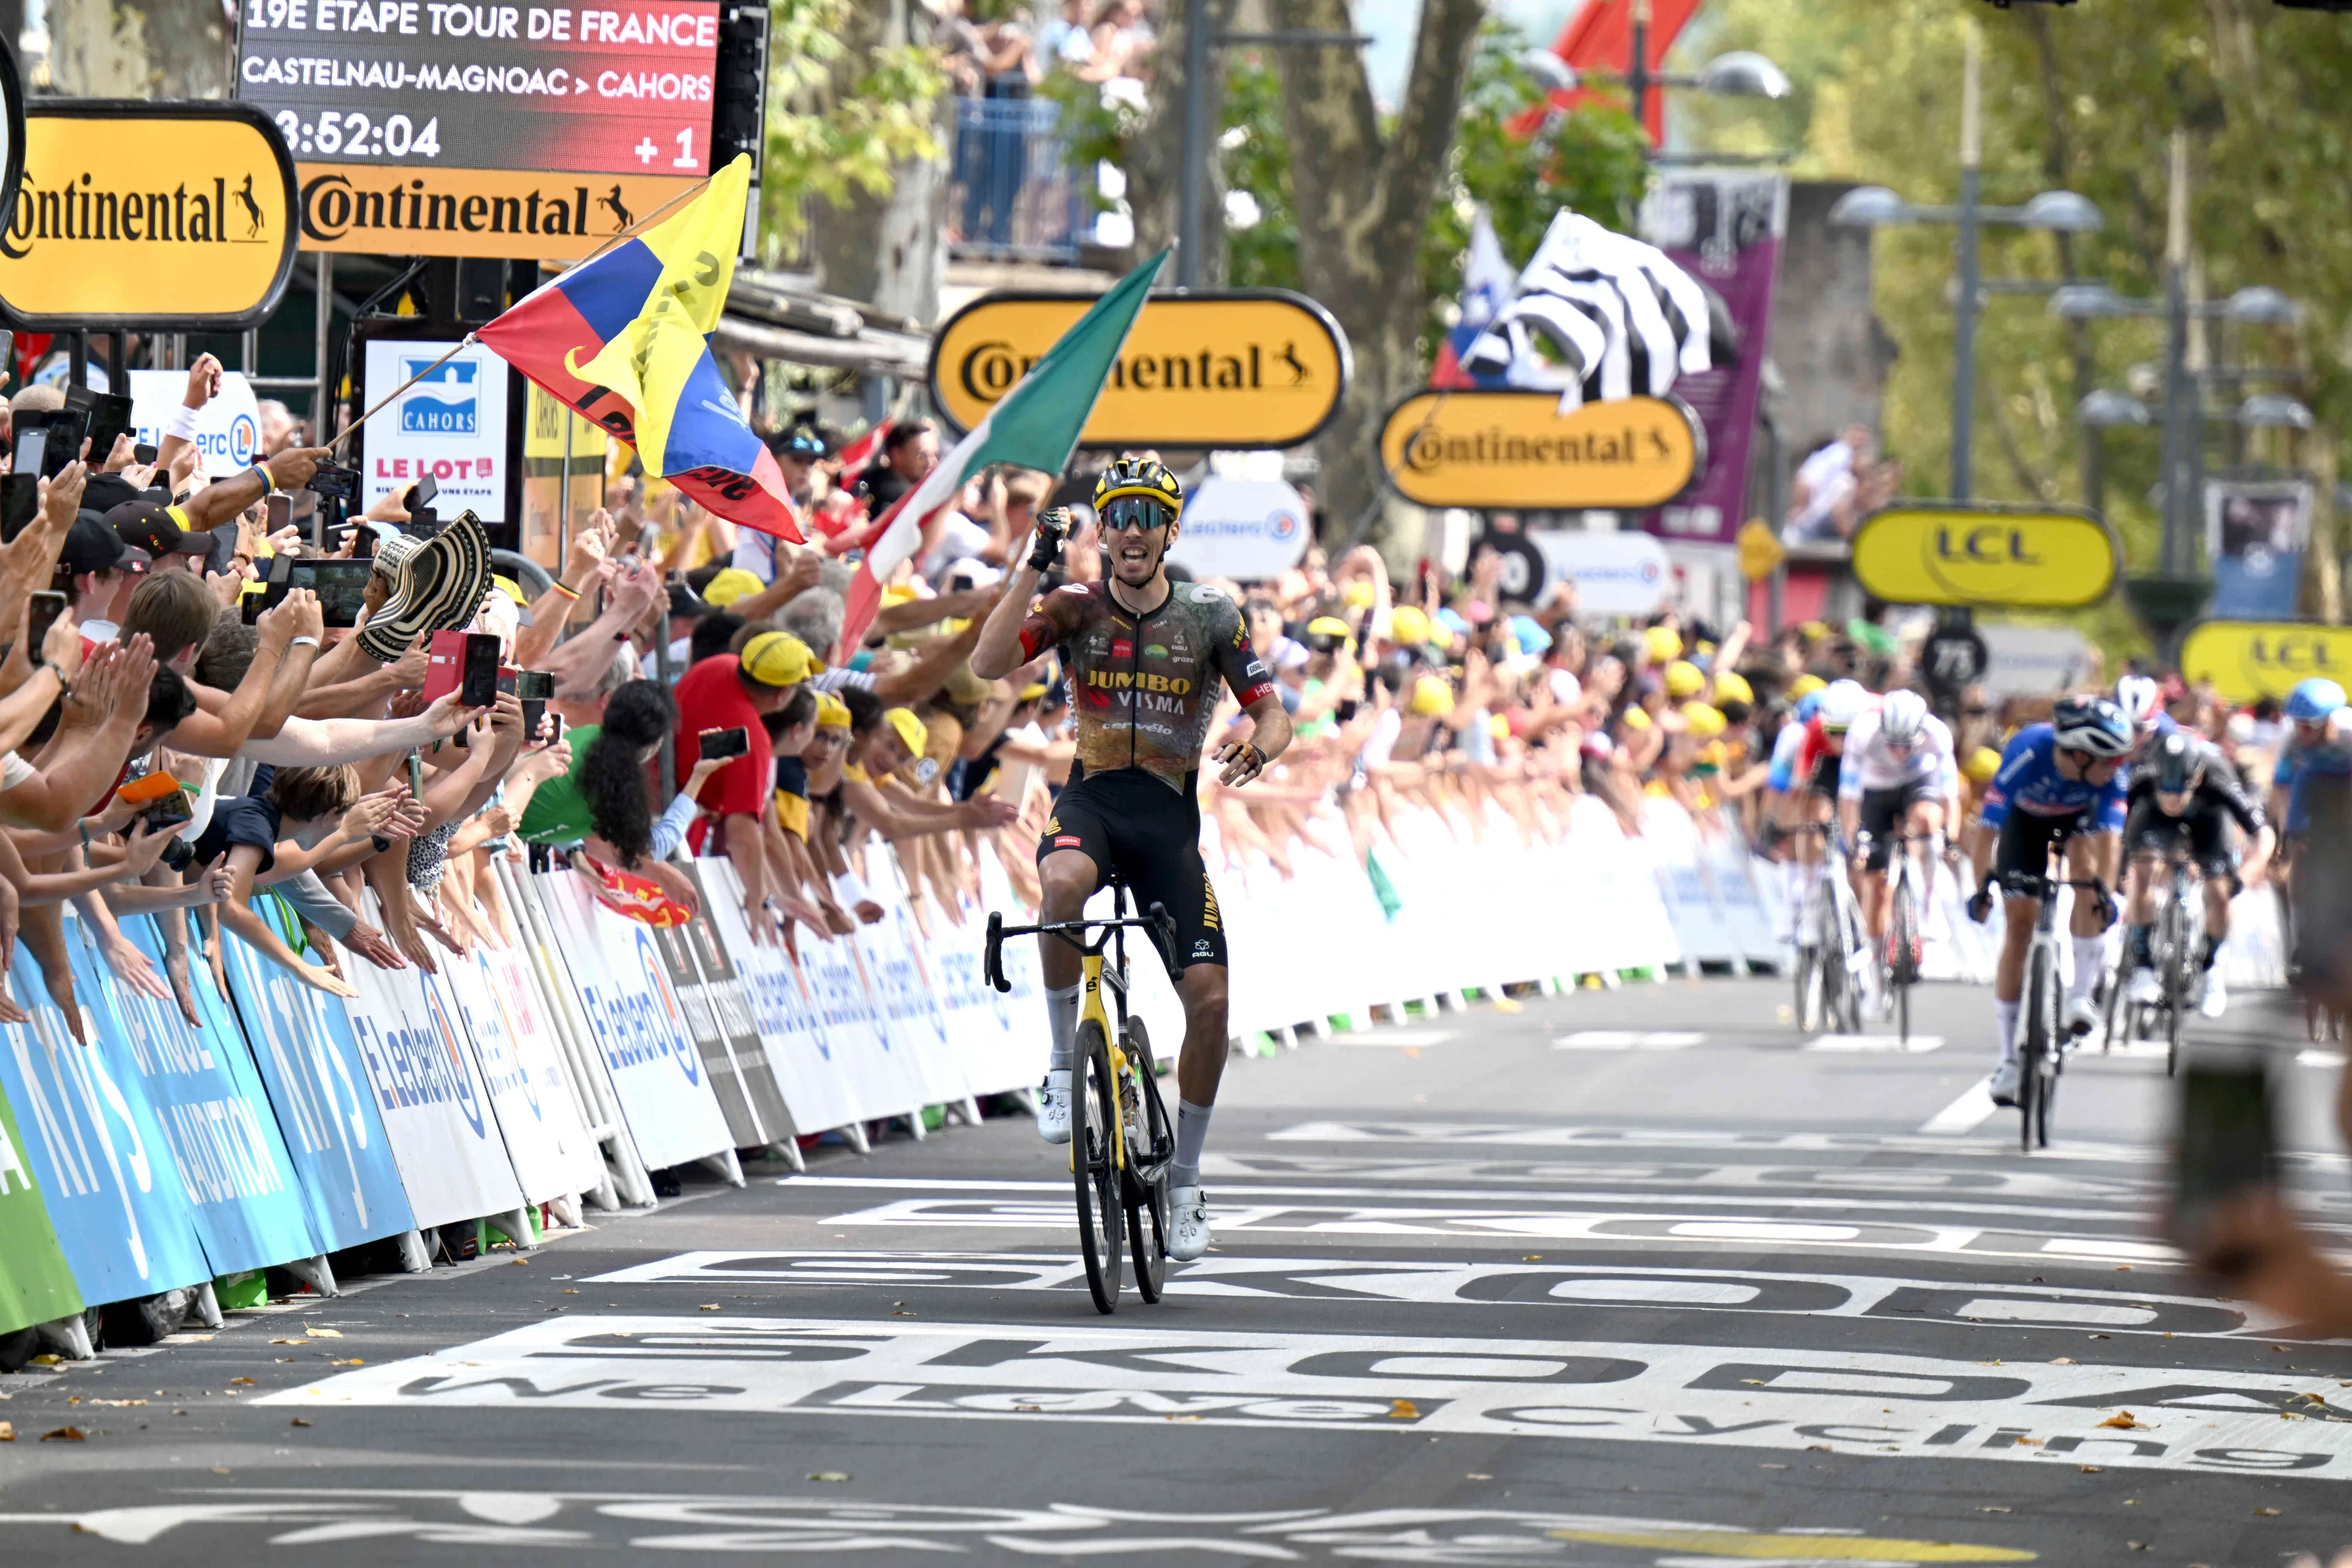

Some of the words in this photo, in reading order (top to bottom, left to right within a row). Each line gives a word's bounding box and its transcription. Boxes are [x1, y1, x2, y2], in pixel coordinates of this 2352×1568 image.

[247, 0, 306, 29] 19E
[316, 1, 419, 34] ETAPE
[427, 3, 519, 39] TOUR
[527, 9, 571, 40] DE
[580, 10, 716, 47] FRANCE
[242, 56, 568, 96] CASTELNAU-MAGNOAC
[597, 70, 712, 100] CAHORS
[275, 110, 440, 157] 3:52:04
[300, 174, 589, 241] Continental
[404, 412, 475, 431] CAHORS
[376, 458, 409, 478] LE
[416, 458, 472, 480] LOT
[1403, 424, 1635, 473] Continental
[1937, 525, 2040, 566] LCL
[2252, 635, 2340, 673] LCL
[1087, 670, 1191, 695] JUMBO
[1117, 691, 1185, 715] VISMA
[1102, 722, 1172, 735] cervélo
[654, 1252, 2315, 1339] ŠKOD
[526, 1325, 2352, 1422] ŠKODA
[396, 1375, 748, 1401] We
[1481, 1404, 2335, 1471] Cycling
